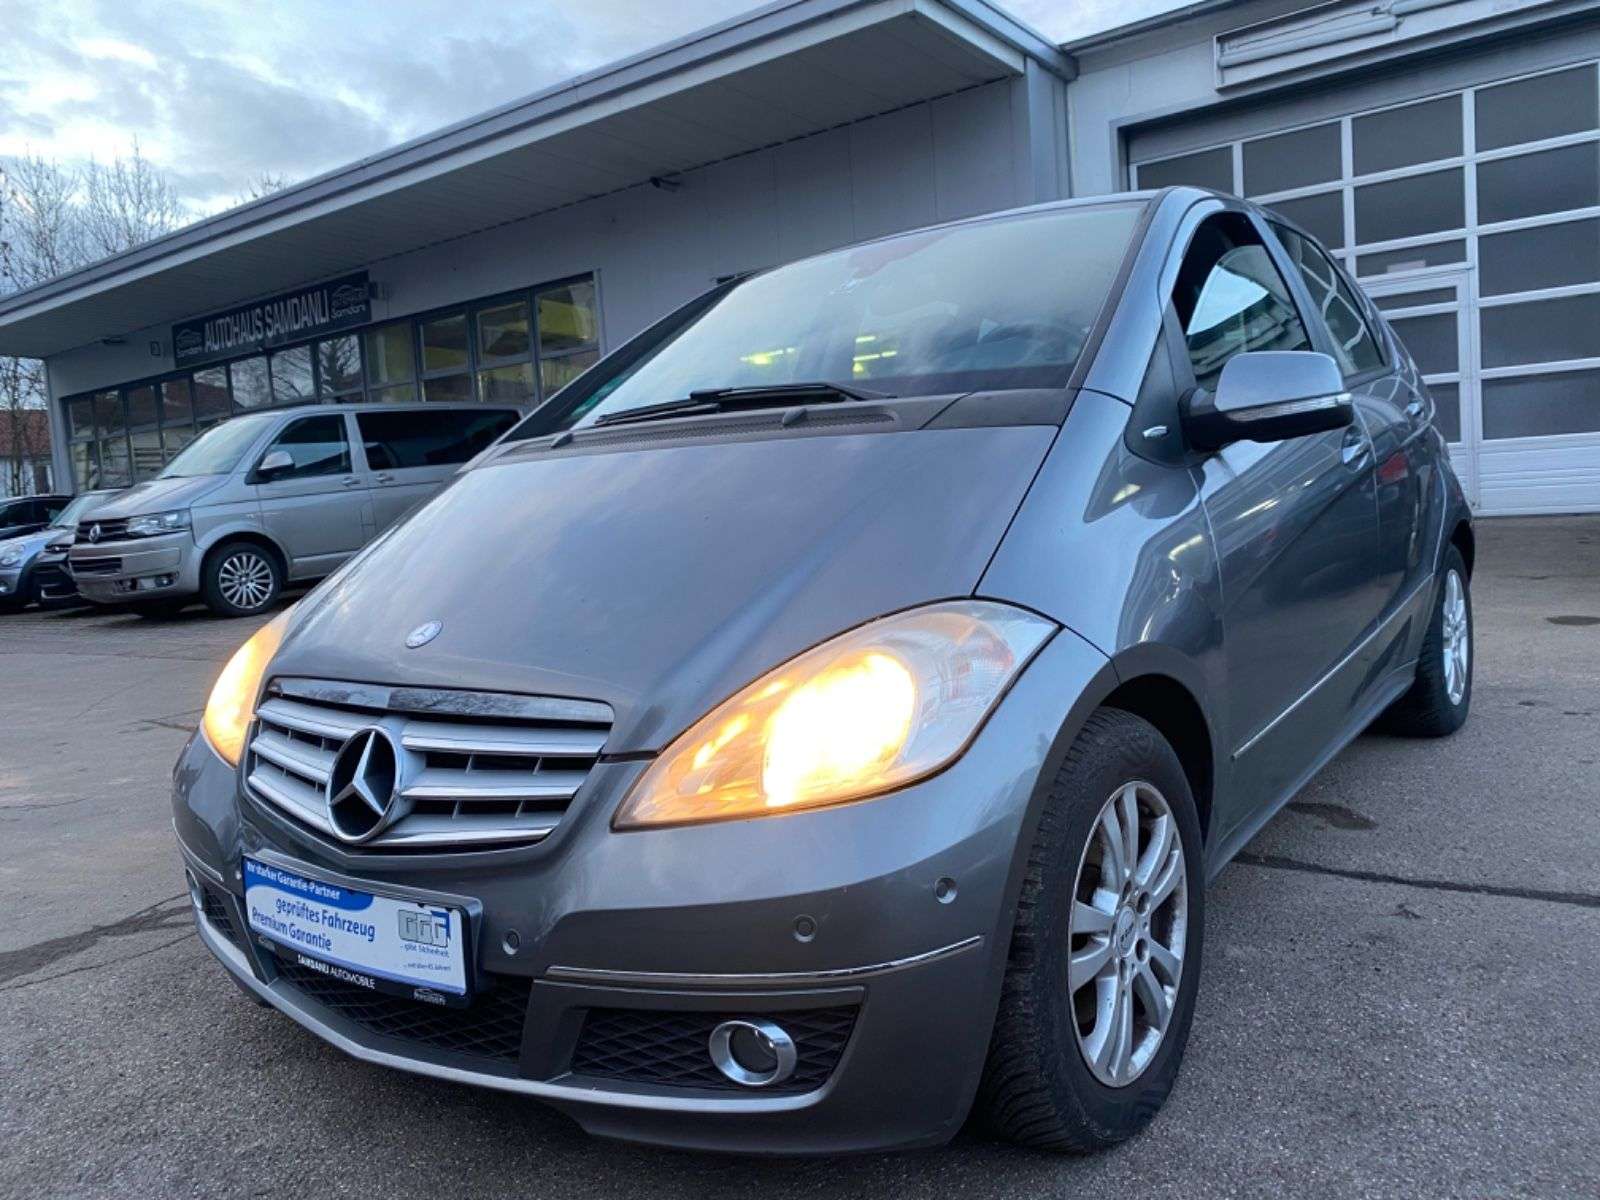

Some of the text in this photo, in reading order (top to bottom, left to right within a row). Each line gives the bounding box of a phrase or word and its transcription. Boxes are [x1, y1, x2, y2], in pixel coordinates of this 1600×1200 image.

[204, 308, 264, 353] AUTOHAUS
[252, 906, 332, 951] Premium Garantie
[275, 898, 376, 942] geprüftes Fahrzeug
[330, 966, 376, 990] AUTOMOBILE
